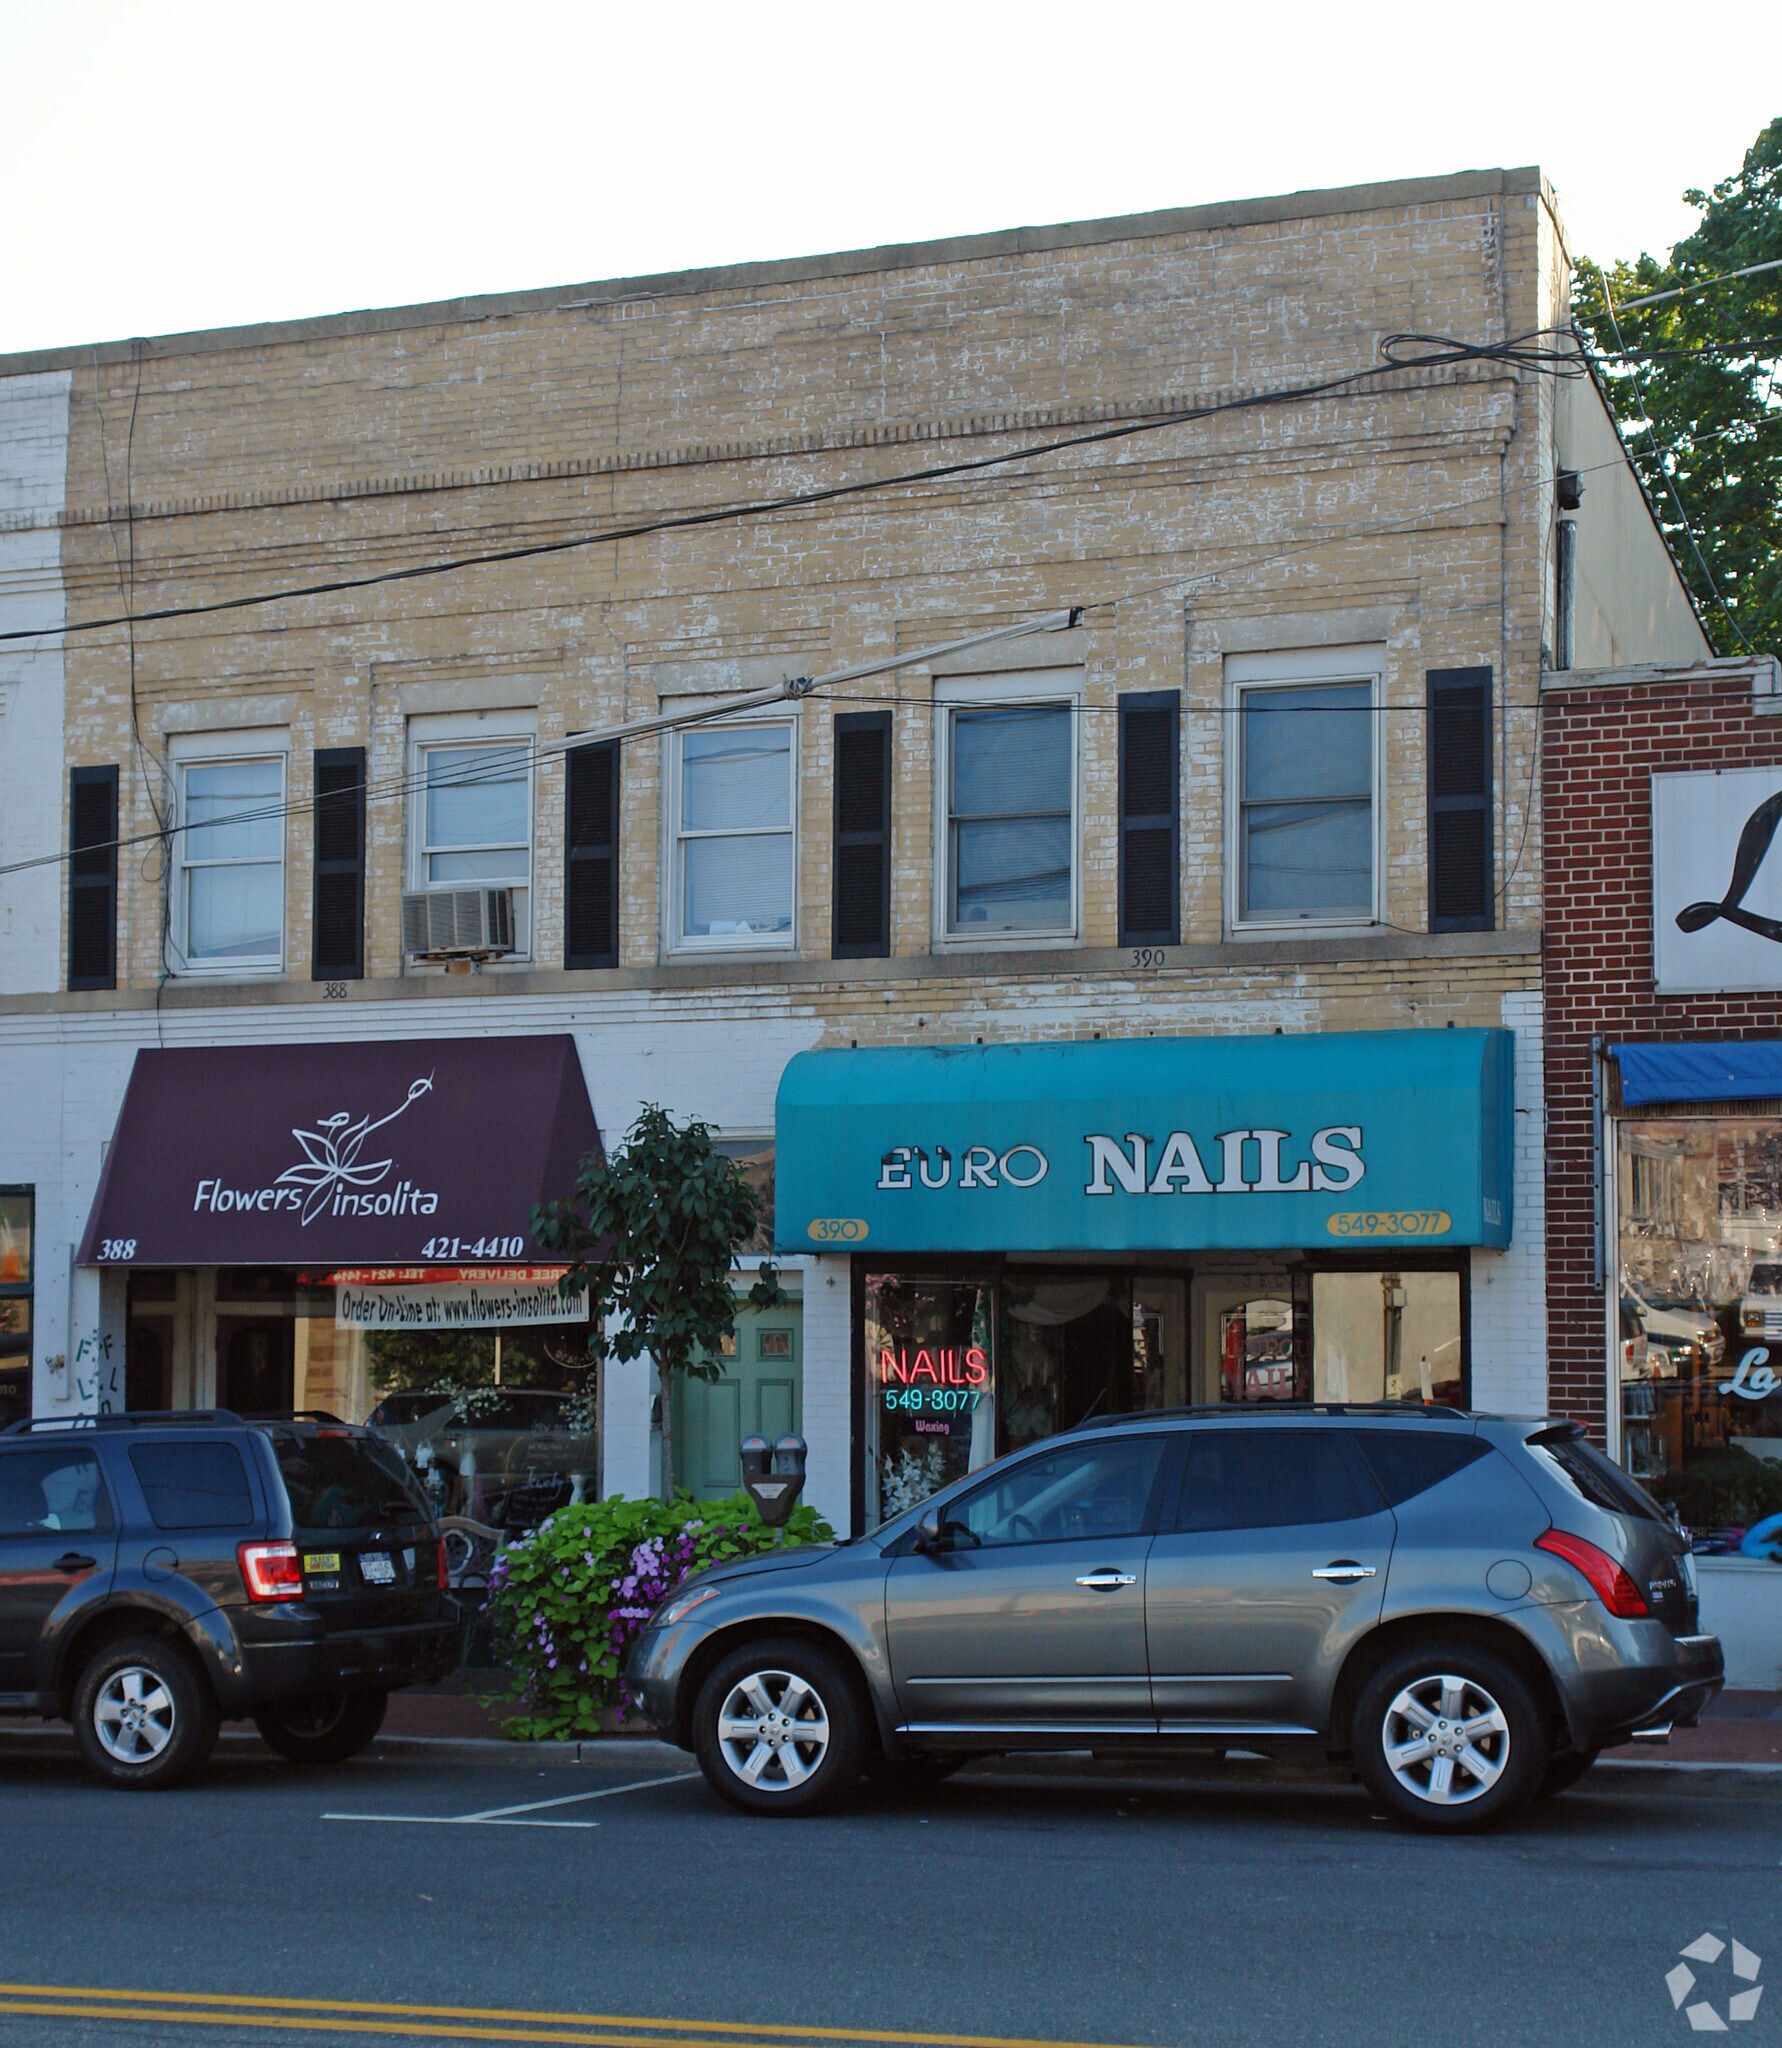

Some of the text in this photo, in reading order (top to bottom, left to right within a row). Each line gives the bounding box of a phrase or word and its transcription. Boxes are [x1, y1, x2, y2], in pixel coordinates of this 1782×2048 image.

[1130, 949, 1165, 968] 390
[322, 982, 348, 999] 388
[876, 1144, 1050, 1189] EURO
[1083, 1125, 1367, 1196] NAILS
[193, 1178, 304, 1213] Flowers
[332, 1180, 439, 1216] insolita
[817, 1220, 859, 1239] 390
[1337, 1212, 1441, 1235] 549-3077
[96, 1239, 137, 1260] 388
[421, 1236, 524, 1258] 421-4410
[342, 1289, 376, 1320] Order
[425, 1296, 441, 1322] at:
[881, 1348, 987, 1385] NAILS
[1718, 1346, 1782, 1400] La
[885, 1388, 981, 1411] 549-3077
[915, 1419, 951, 1435] Waxing
